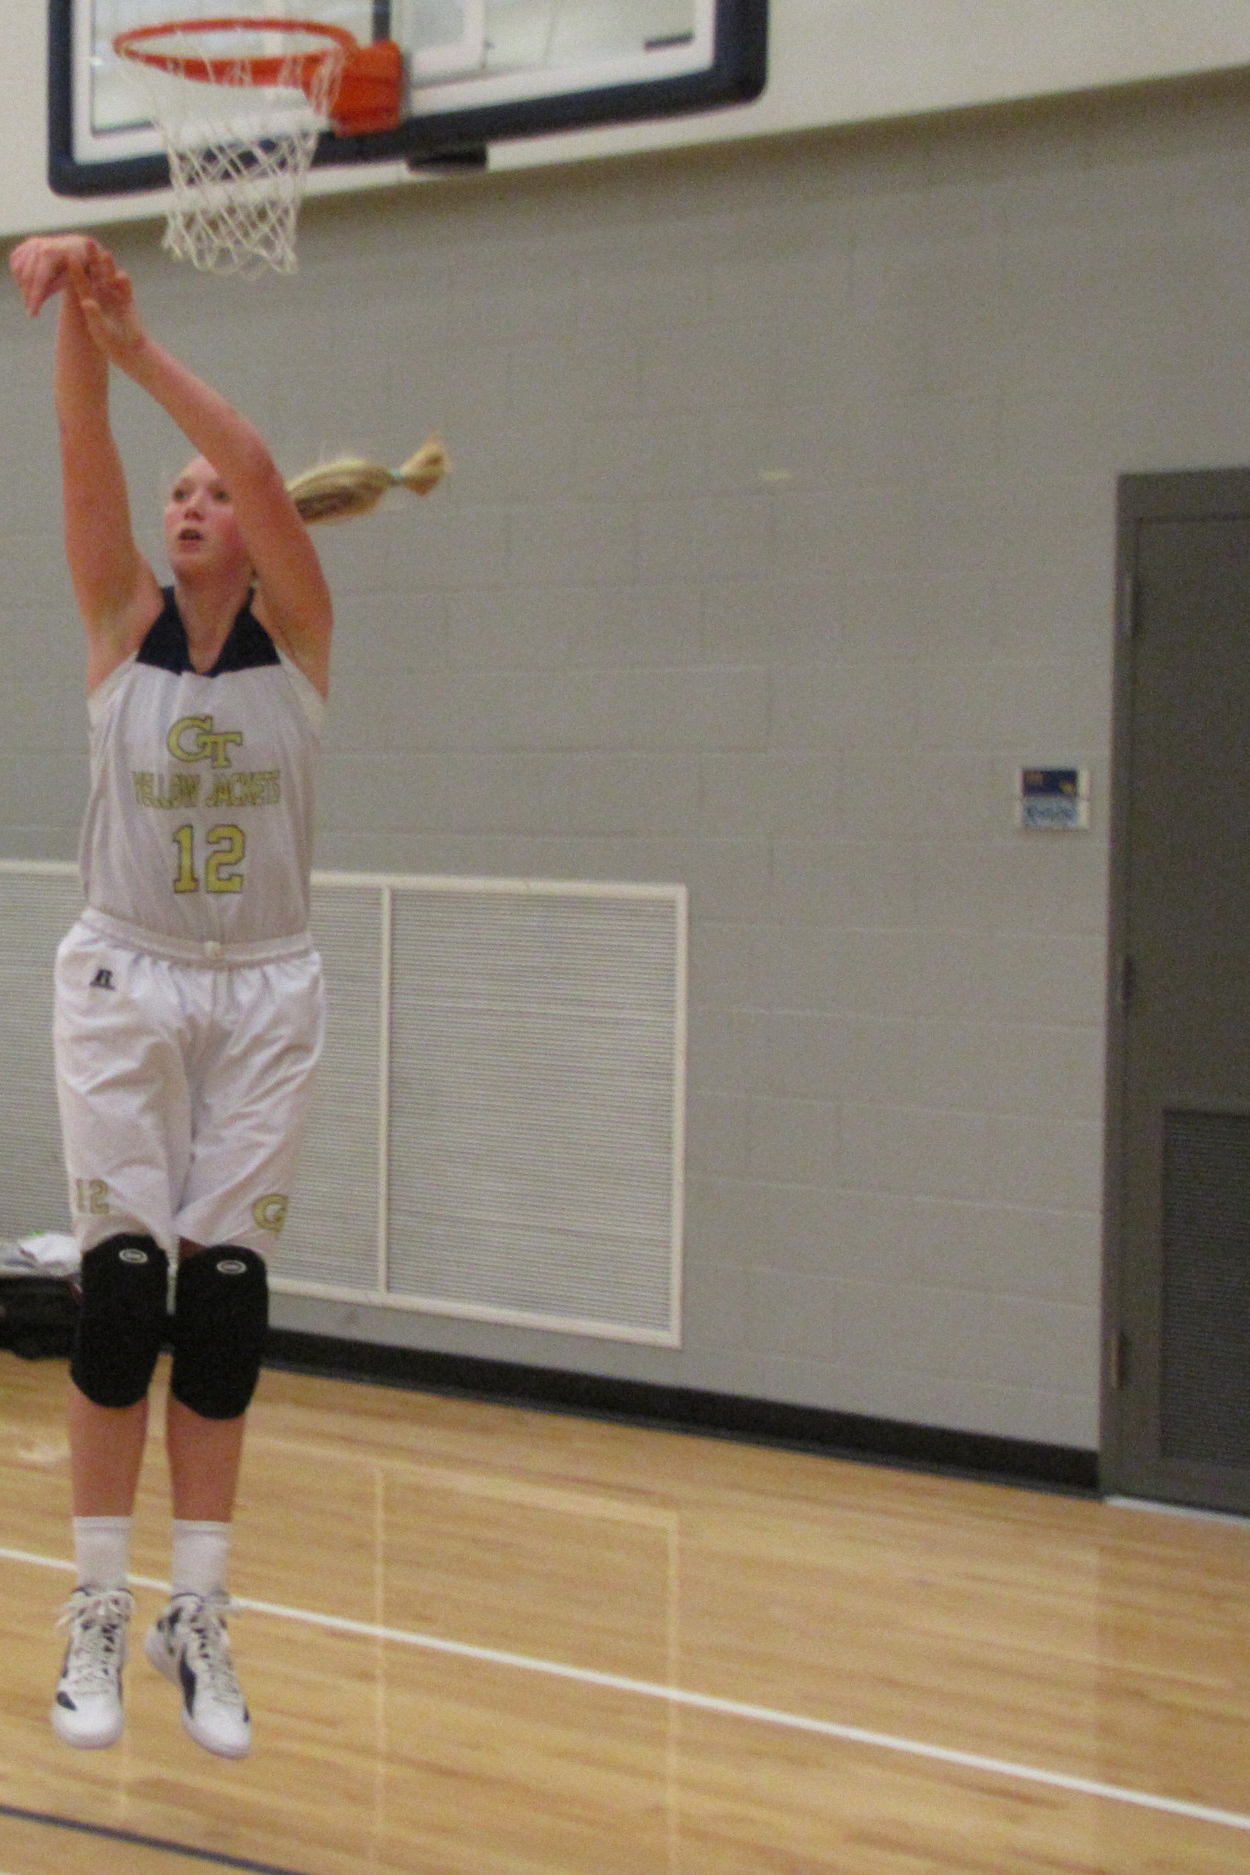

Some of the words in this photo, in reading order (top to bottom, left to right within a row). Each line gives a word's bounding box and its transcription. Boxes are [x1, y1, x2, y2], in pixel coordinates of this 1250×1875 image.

[167, 713, 244, 769] GT
[172, 823, 246, 895] 12
[75, 1178, 109, 1215] 12
